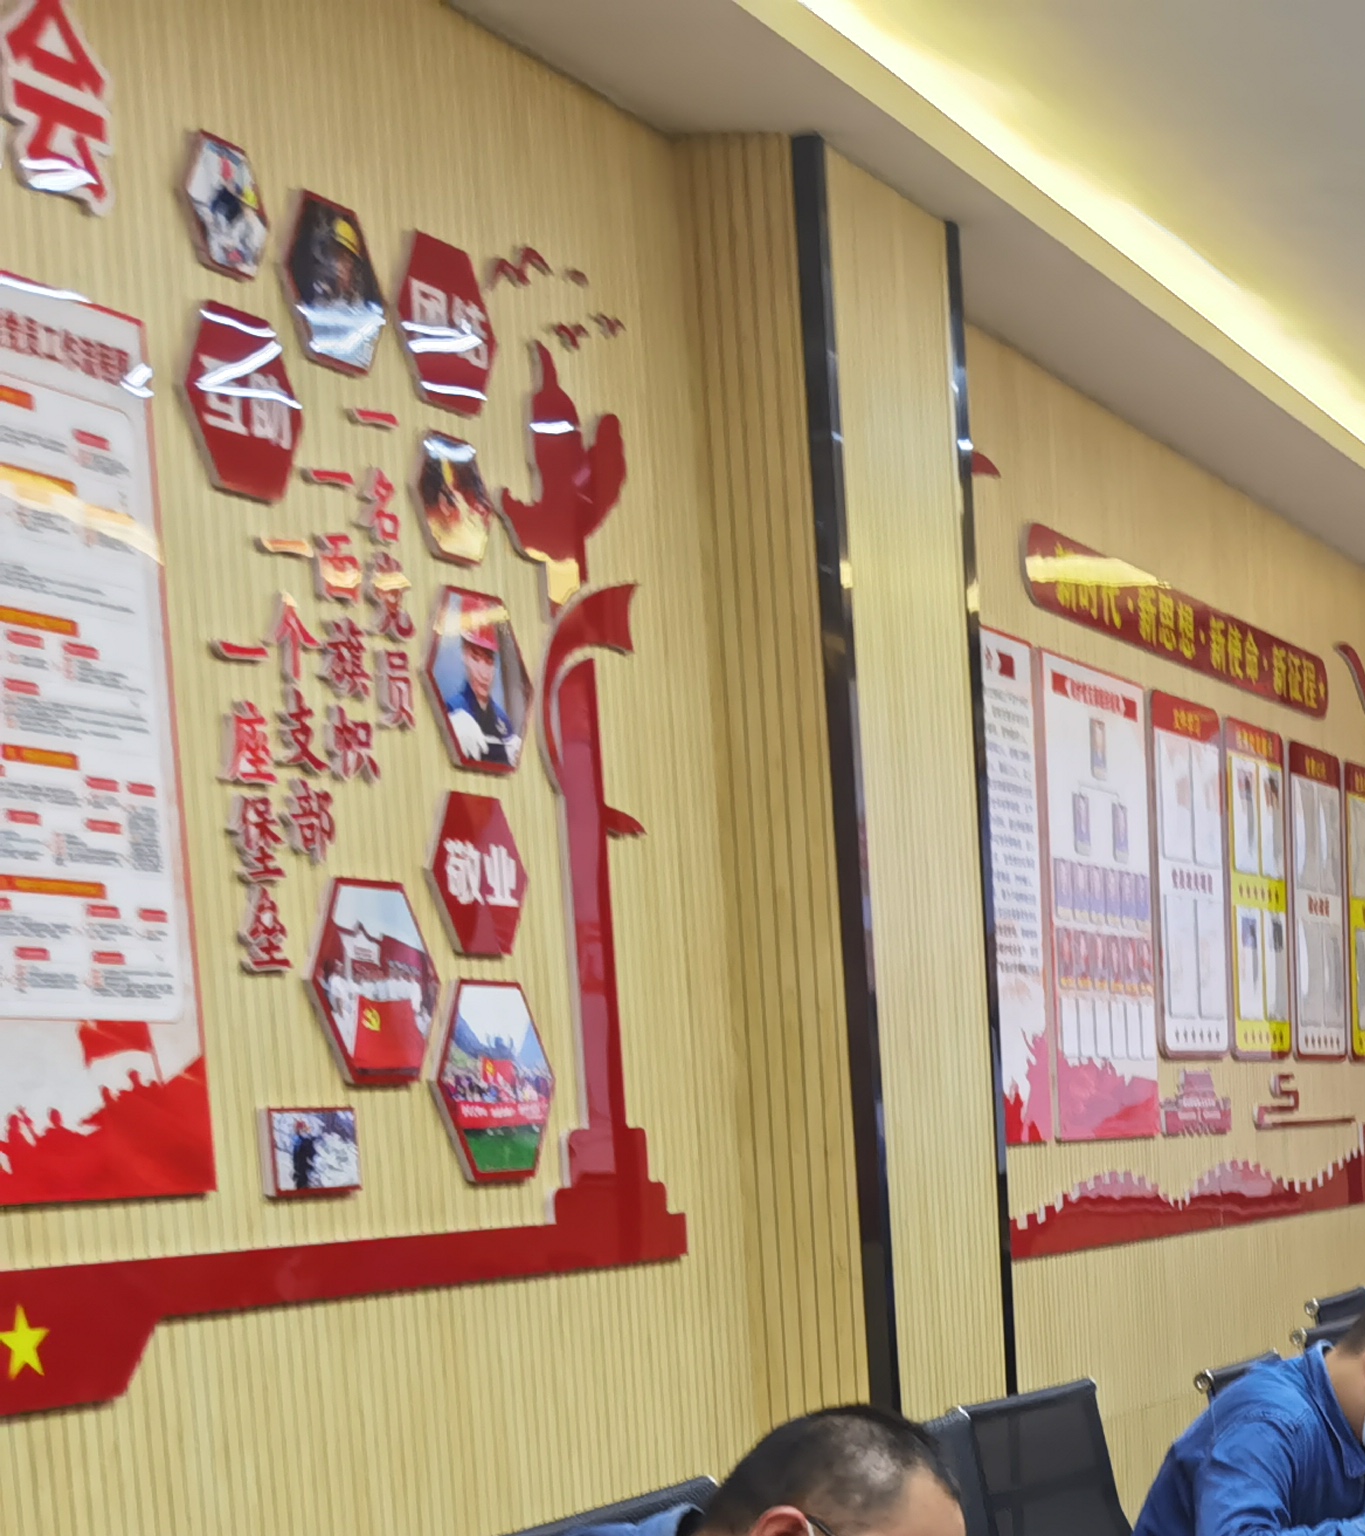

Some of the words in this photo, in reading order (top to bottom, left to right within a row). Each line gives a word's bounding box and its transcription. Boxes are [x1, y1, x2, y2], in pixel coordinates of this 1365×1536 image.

[261, 536, 337, 864] 一个支部
[309, 468, 381, 782] 一面旗帜
[353, 407, 416, 729] 一名党员
[220, 640, 292, 972] 一座堡垒
[443, 837, 520, 907] 敬业
